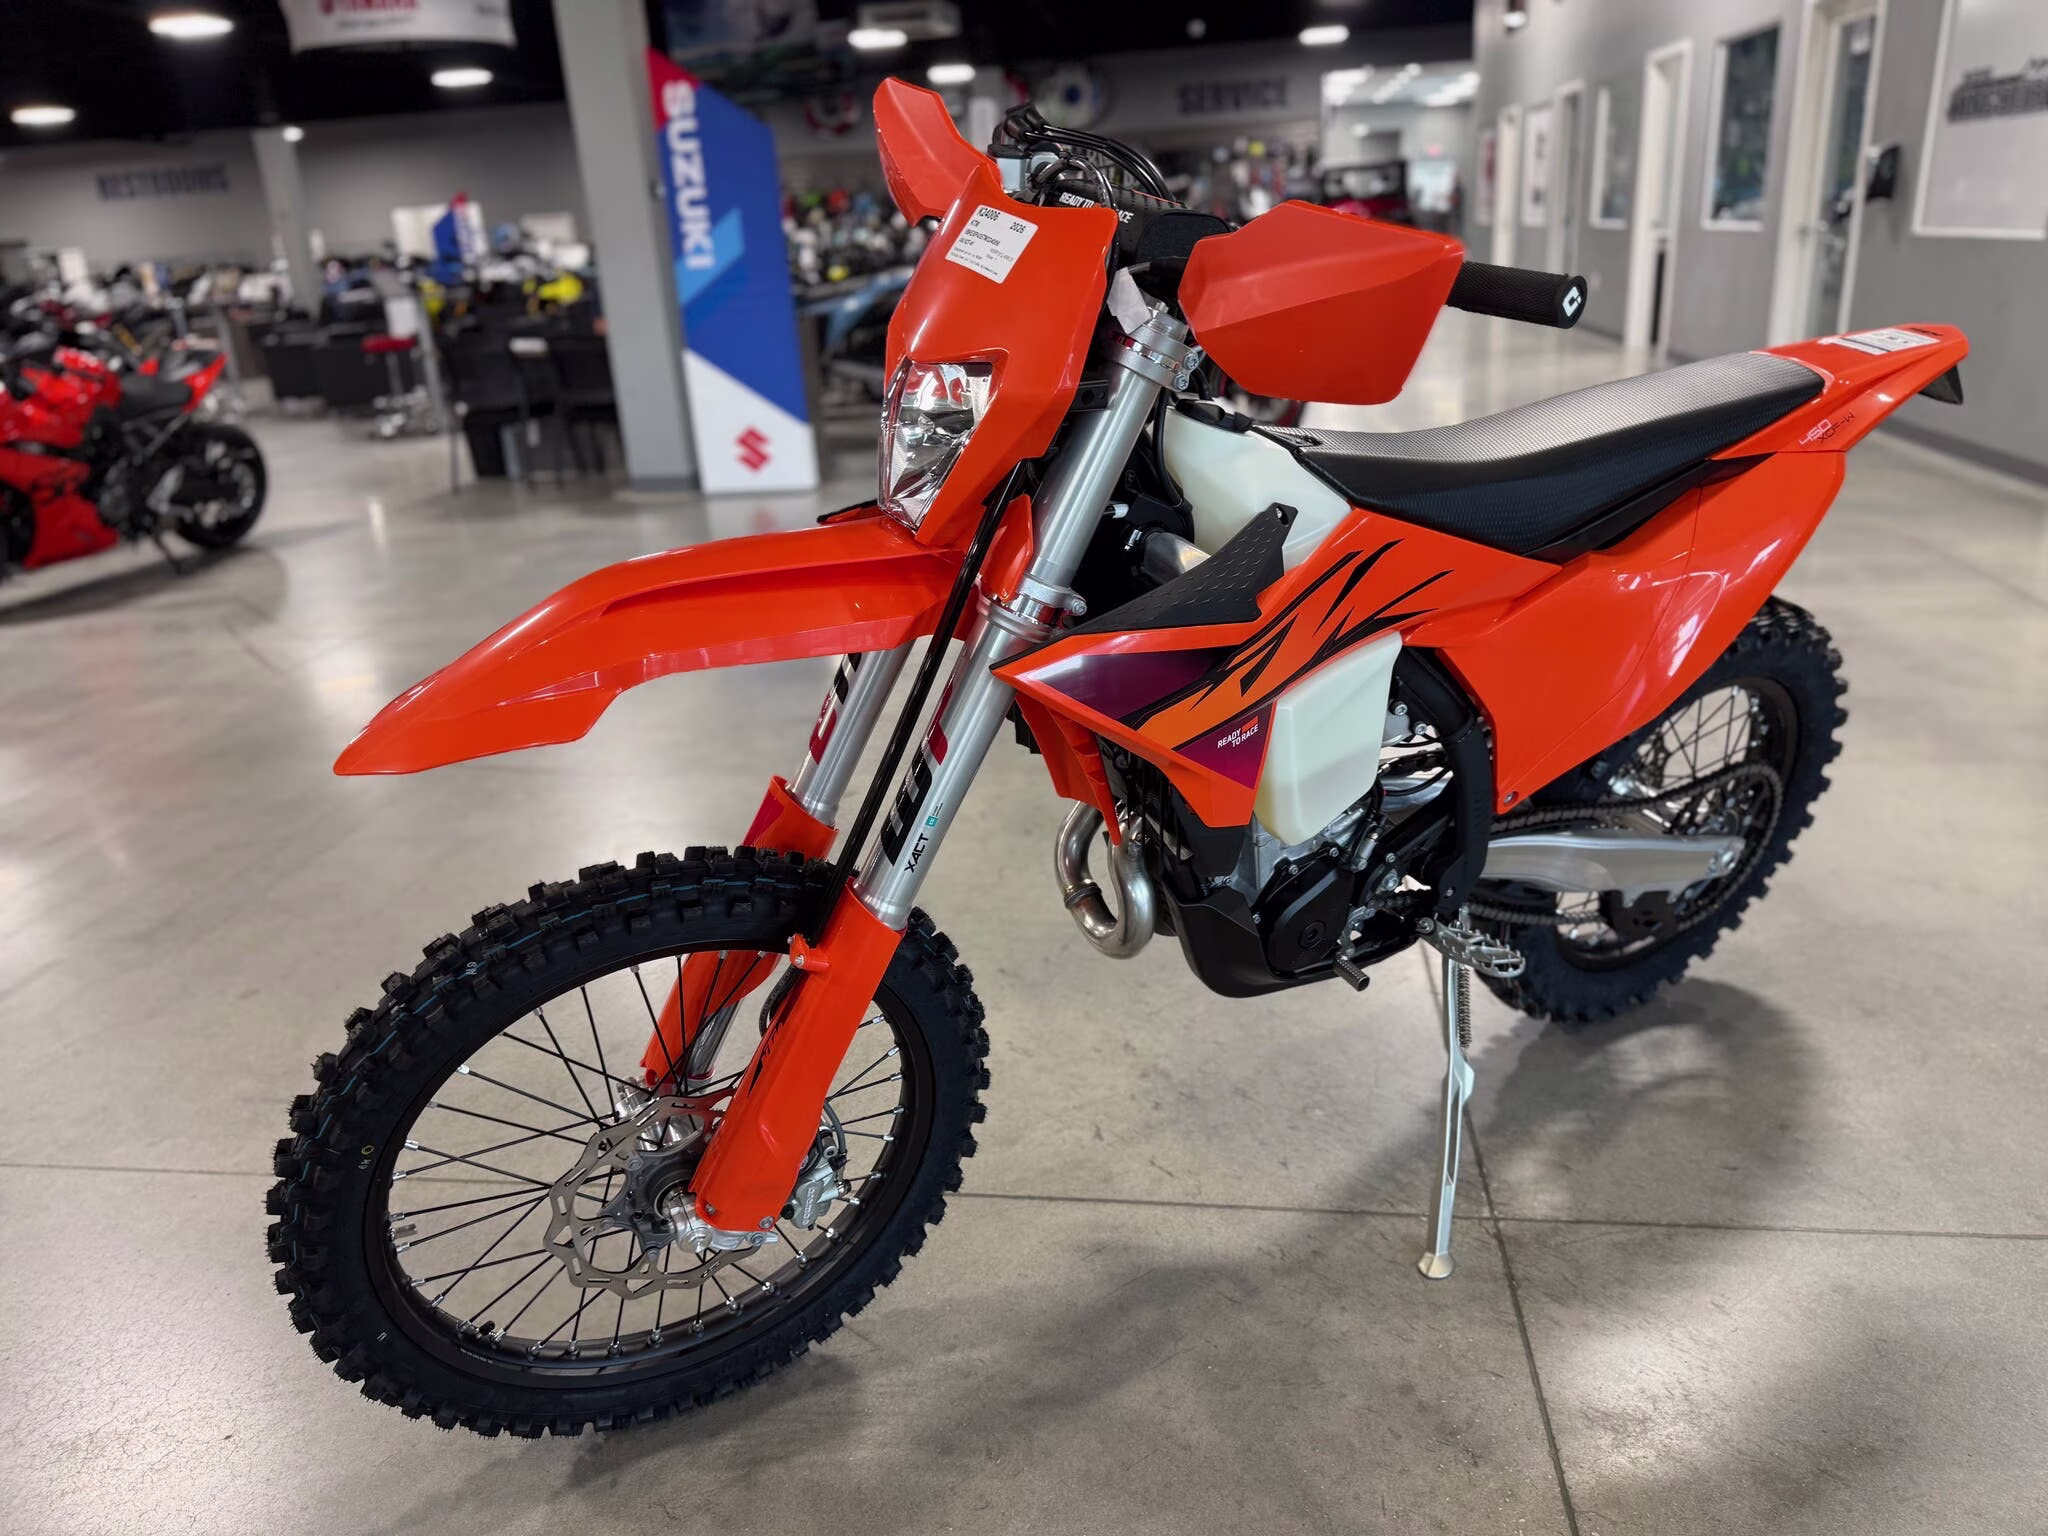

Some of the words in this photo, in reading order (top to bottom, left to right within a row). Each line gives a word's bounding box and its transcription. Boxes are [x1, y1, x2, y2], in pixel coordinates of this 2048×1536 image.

[662, 79, 716, 270] SUZUKI
[1058, 191, 1085, 207] READY
[1116, 209, 1134, 224] ACE
[1798, 418, 1832, 445] 450
[1217, 727, 1242, 749] READY
[1231, 736, 1242, 748] TO
[1241, 723, 1259, 742] RACE
[904, 832, 929, 873] XACT
